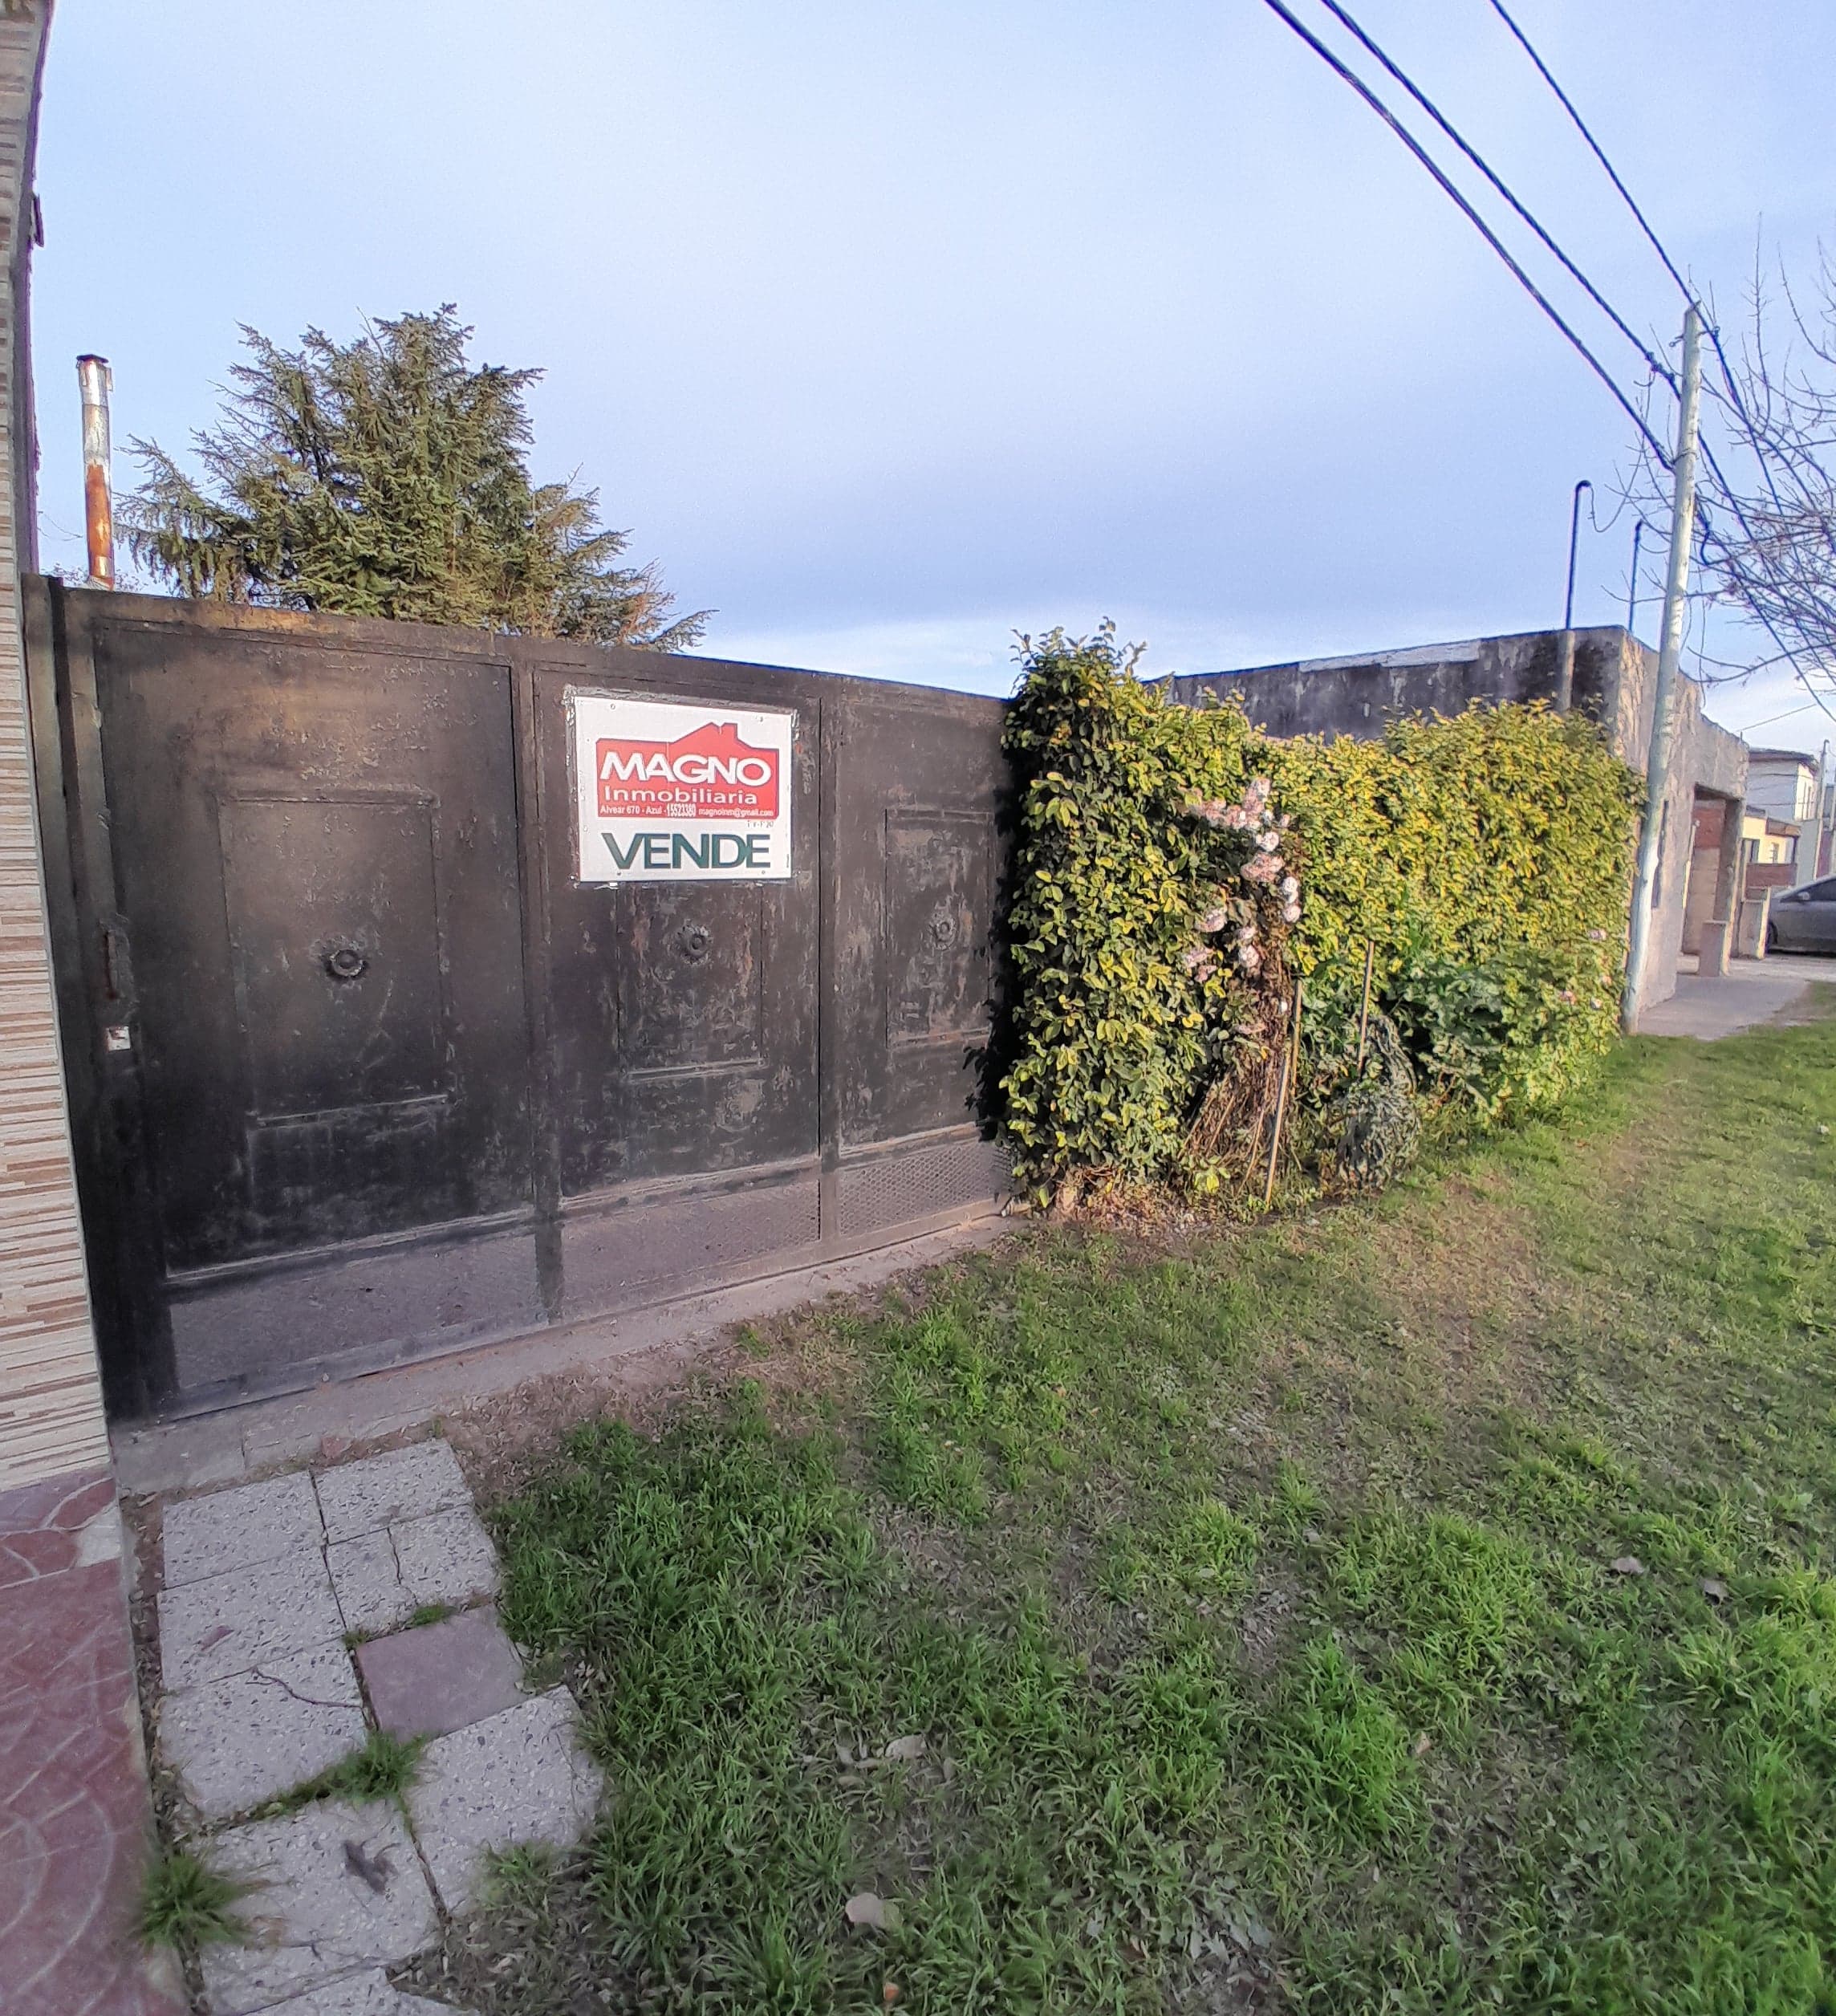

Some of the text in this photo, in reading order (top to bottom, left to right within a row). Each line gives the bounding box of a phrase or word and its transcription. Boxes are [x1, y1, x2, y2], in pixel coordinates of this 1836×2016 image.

[599, 751, 772, 786] MAGNO
[604, 785, 758, 805] Inmobiliaria
[600, 805, 625, 814] Alvear
[626, 805, 640, 815] 670
[645, 806, 662, 815] Azul
[601, 832, 771, 870] VENDE
